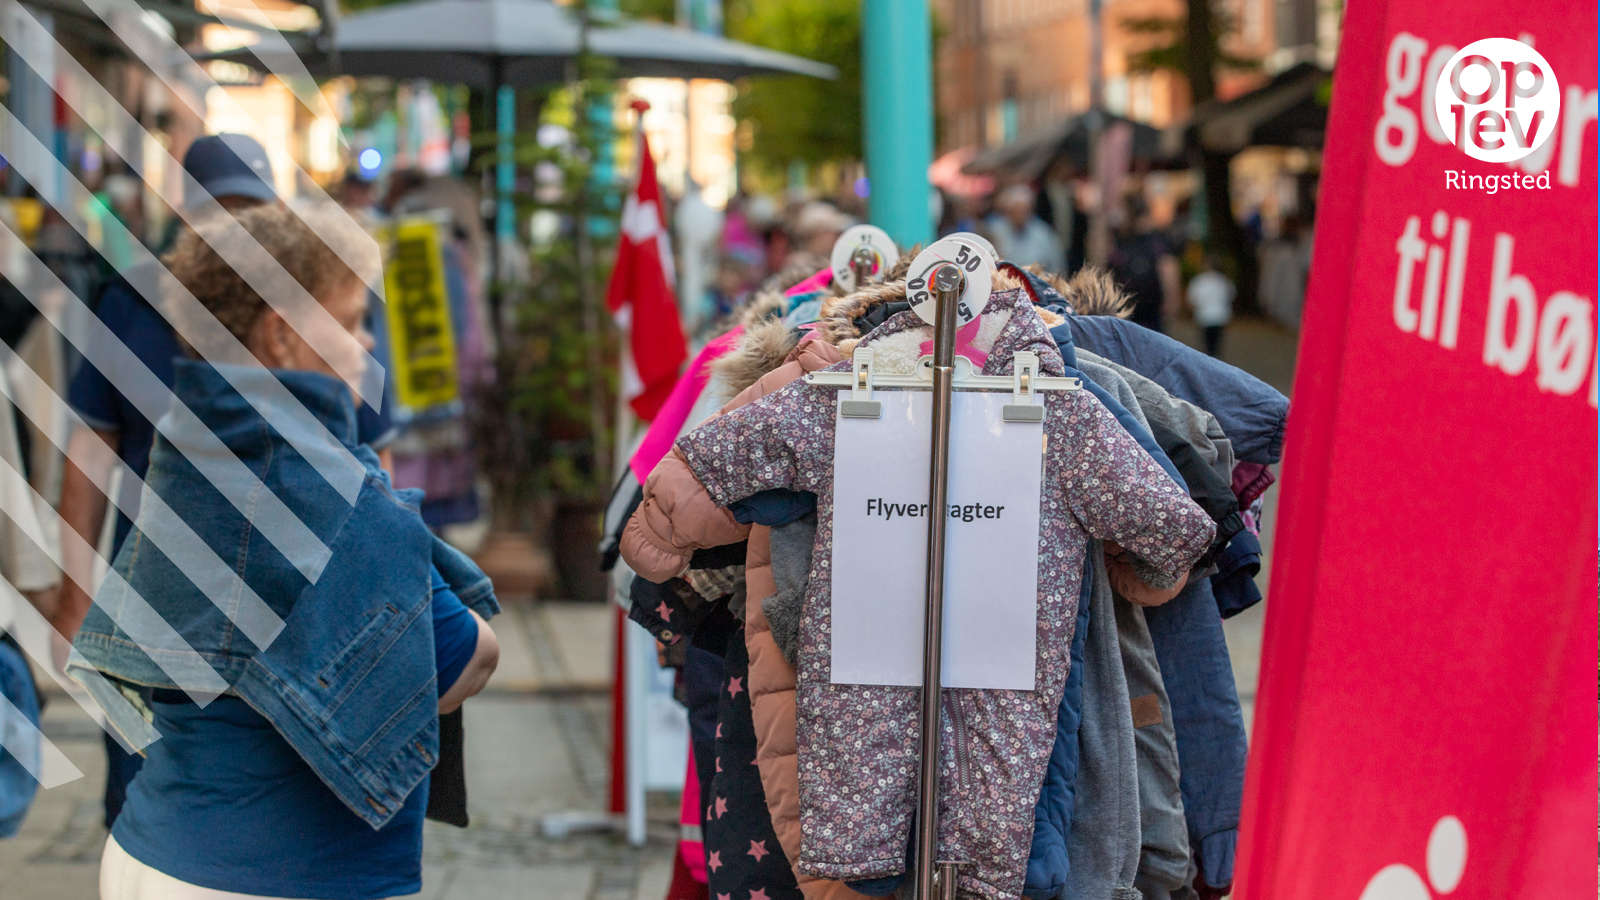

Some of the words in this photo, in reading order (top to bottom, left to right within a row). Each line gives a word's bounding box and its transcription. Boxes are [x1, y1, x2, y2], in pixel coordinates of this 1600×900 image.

[955, 244, 982, 273] 50
[907, 278, 930, 308] 50
[957, 302, 974, 322] 5
[1393, 210, 1470, 350] til
[1483, 232, 1598, 408] bø
[866, 498, 1005, 522] Flyveragter
